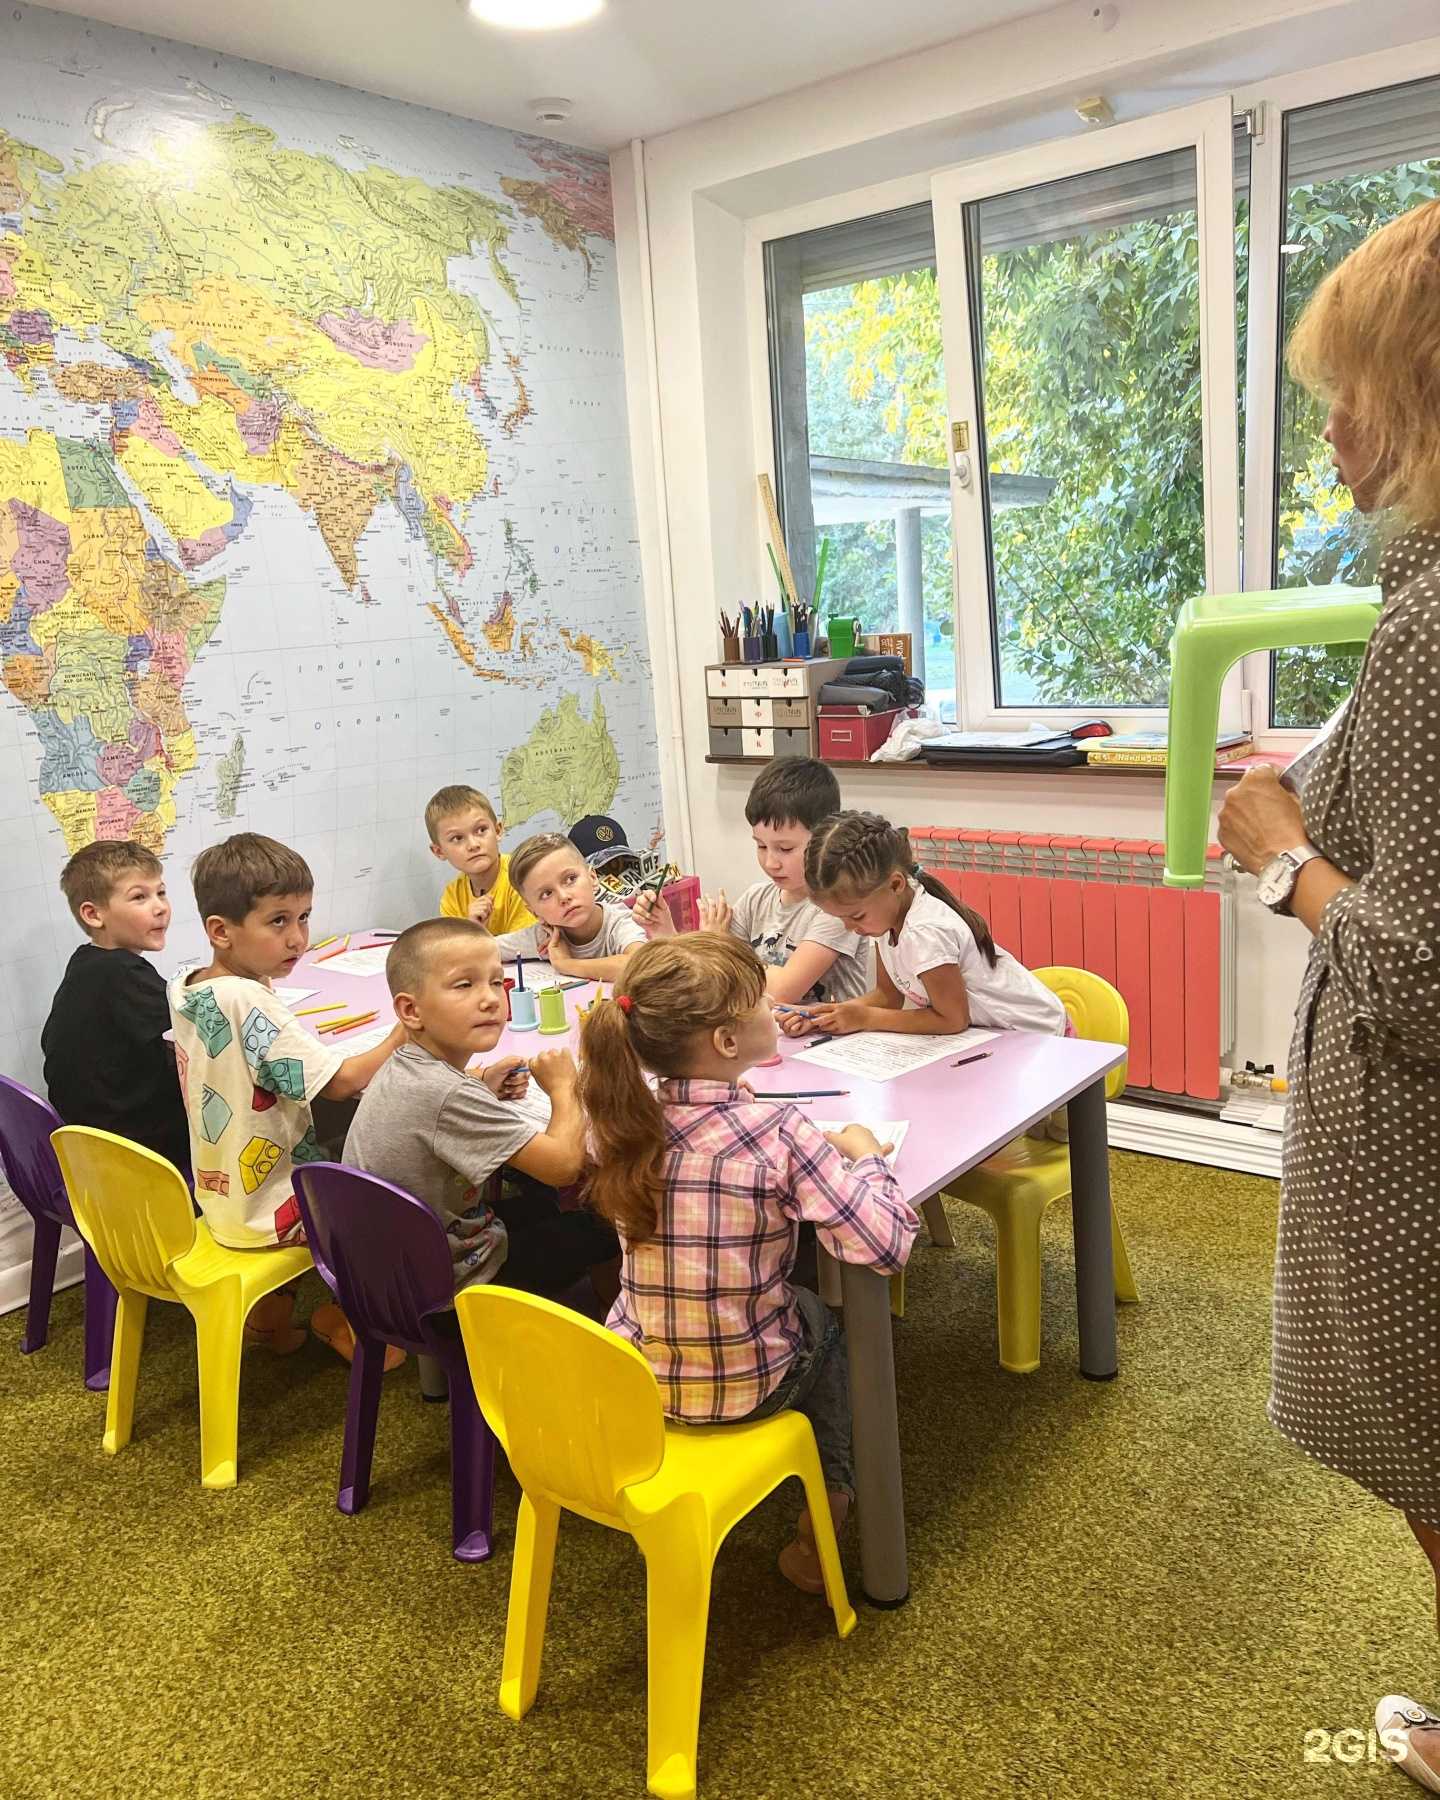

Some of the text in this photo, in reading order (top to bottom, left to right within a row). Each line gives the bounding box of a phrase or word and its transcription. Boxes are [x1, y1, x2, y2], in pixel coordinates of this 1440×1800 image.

[190, 320, 243, 330] KAZAKHSTAN
[540, 505, 617, 516] Pacific
[554, 545, 611, 554] Ocean
[298, 656, 400, 673] Indian
[314, 713, 400, 730] Ocean
[535, 745, 575, 756] AUSTRALIA
[62, 771, 88, 779] ANGOLA
